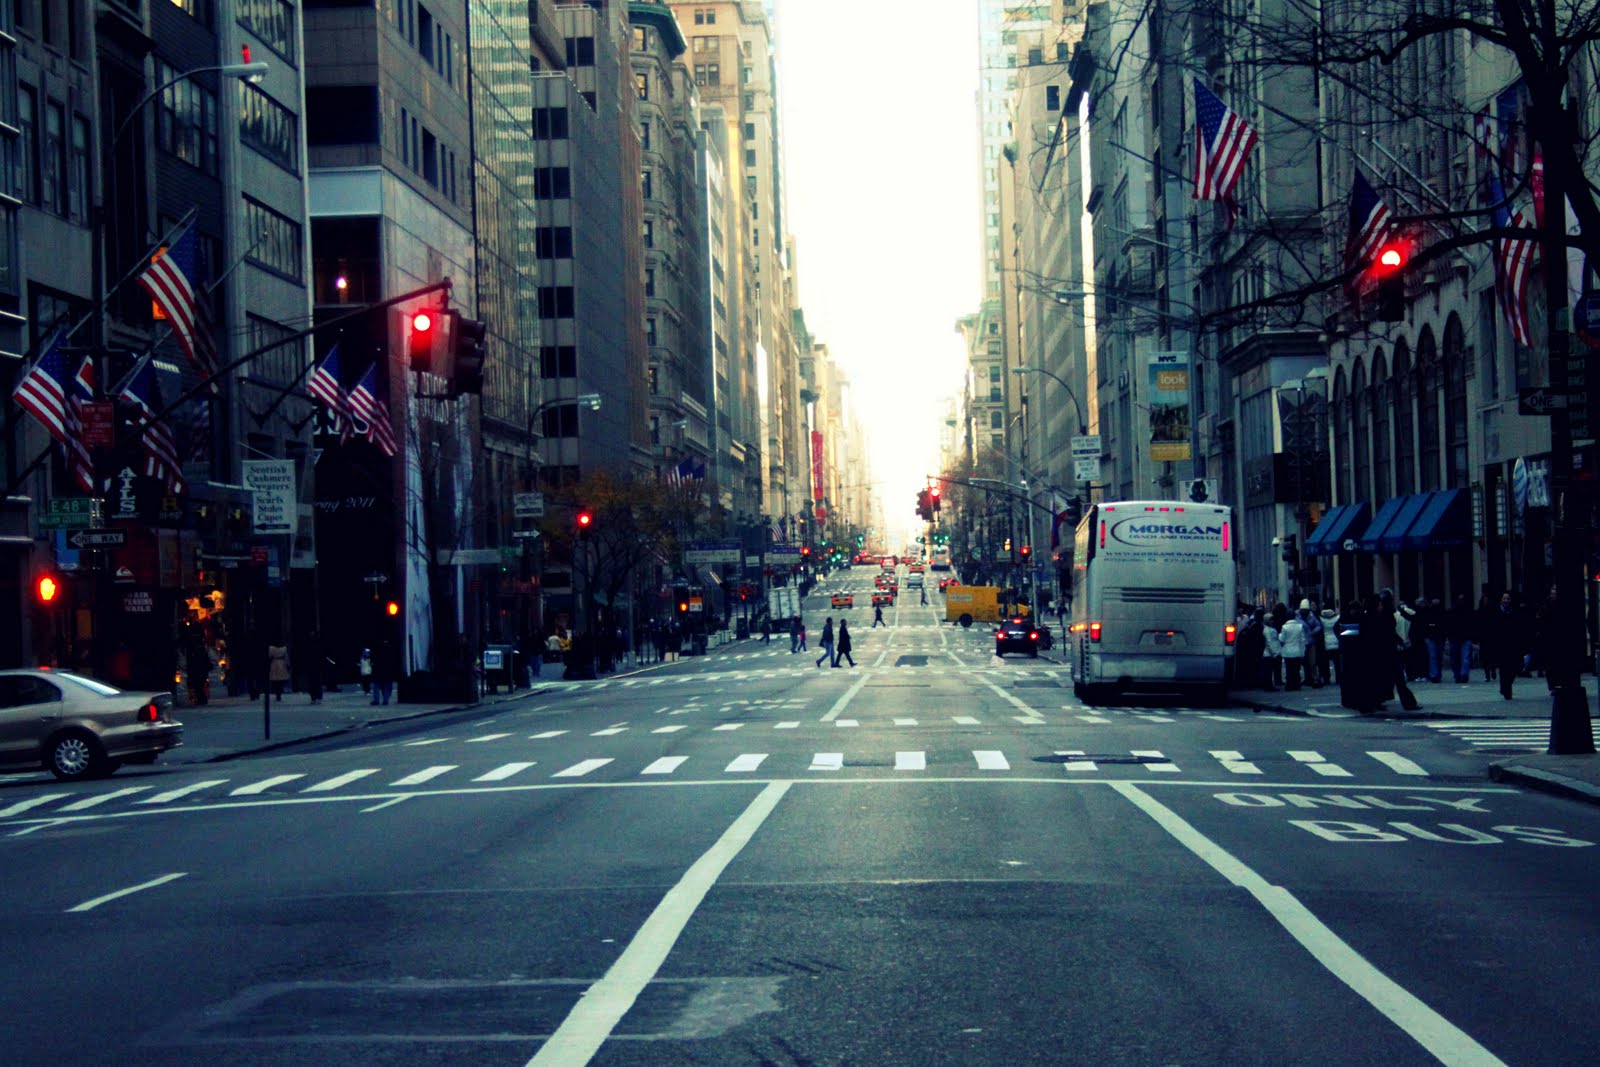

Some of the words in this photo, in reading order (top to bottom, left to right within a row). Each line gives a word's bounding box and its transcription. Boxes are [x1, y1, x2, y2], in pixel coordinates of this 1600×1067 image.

[1158, 355, 1177, 363] NYC
[1160, 373, 1186, 385] look
[1531, 394, 1553, 408] ONE
[249, 465, 287, 474] Scottish
[246, 474, 291, 482] Cashmere
[117, 465, 138, 513] AILS
[249, 482, 290, 490] Sweaters
[51, 500, 59, 512] E
[62, 500, 80, 512] 48
[257, 505, 283, 513] Stoles
[257, 513, 283, 523] Capes
[1129, 525, 1222, 535] MORGAN
[76, 535, 93, 544] ONE
[101, 534, 121, 544] WAY
[1213, 792, 1492, 813] ONLY
[1288, 820, 1598, 848] BUS
